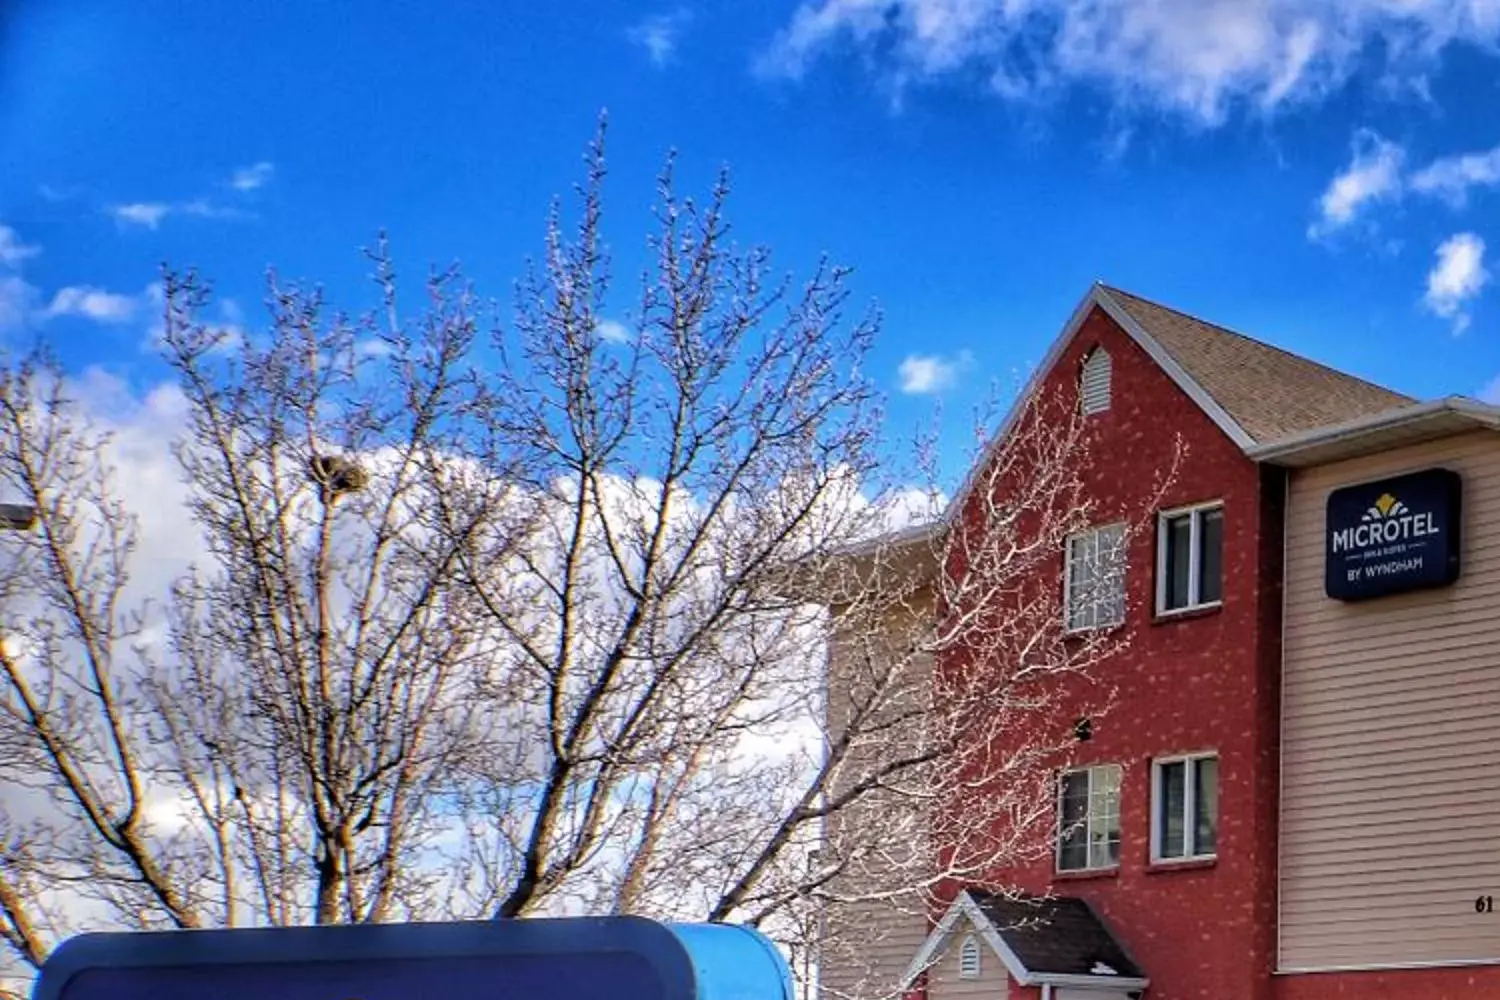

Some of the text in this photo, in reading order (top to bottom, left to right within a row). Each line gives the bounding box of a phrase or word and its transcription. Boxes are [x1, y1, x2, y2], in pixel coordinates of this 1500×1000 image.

[1333, 512, 1439, 552] MICROTEL
[1347, 556, 1423, 581] BY WYNDHAM
[1475, 895, 1493, 913] 61
